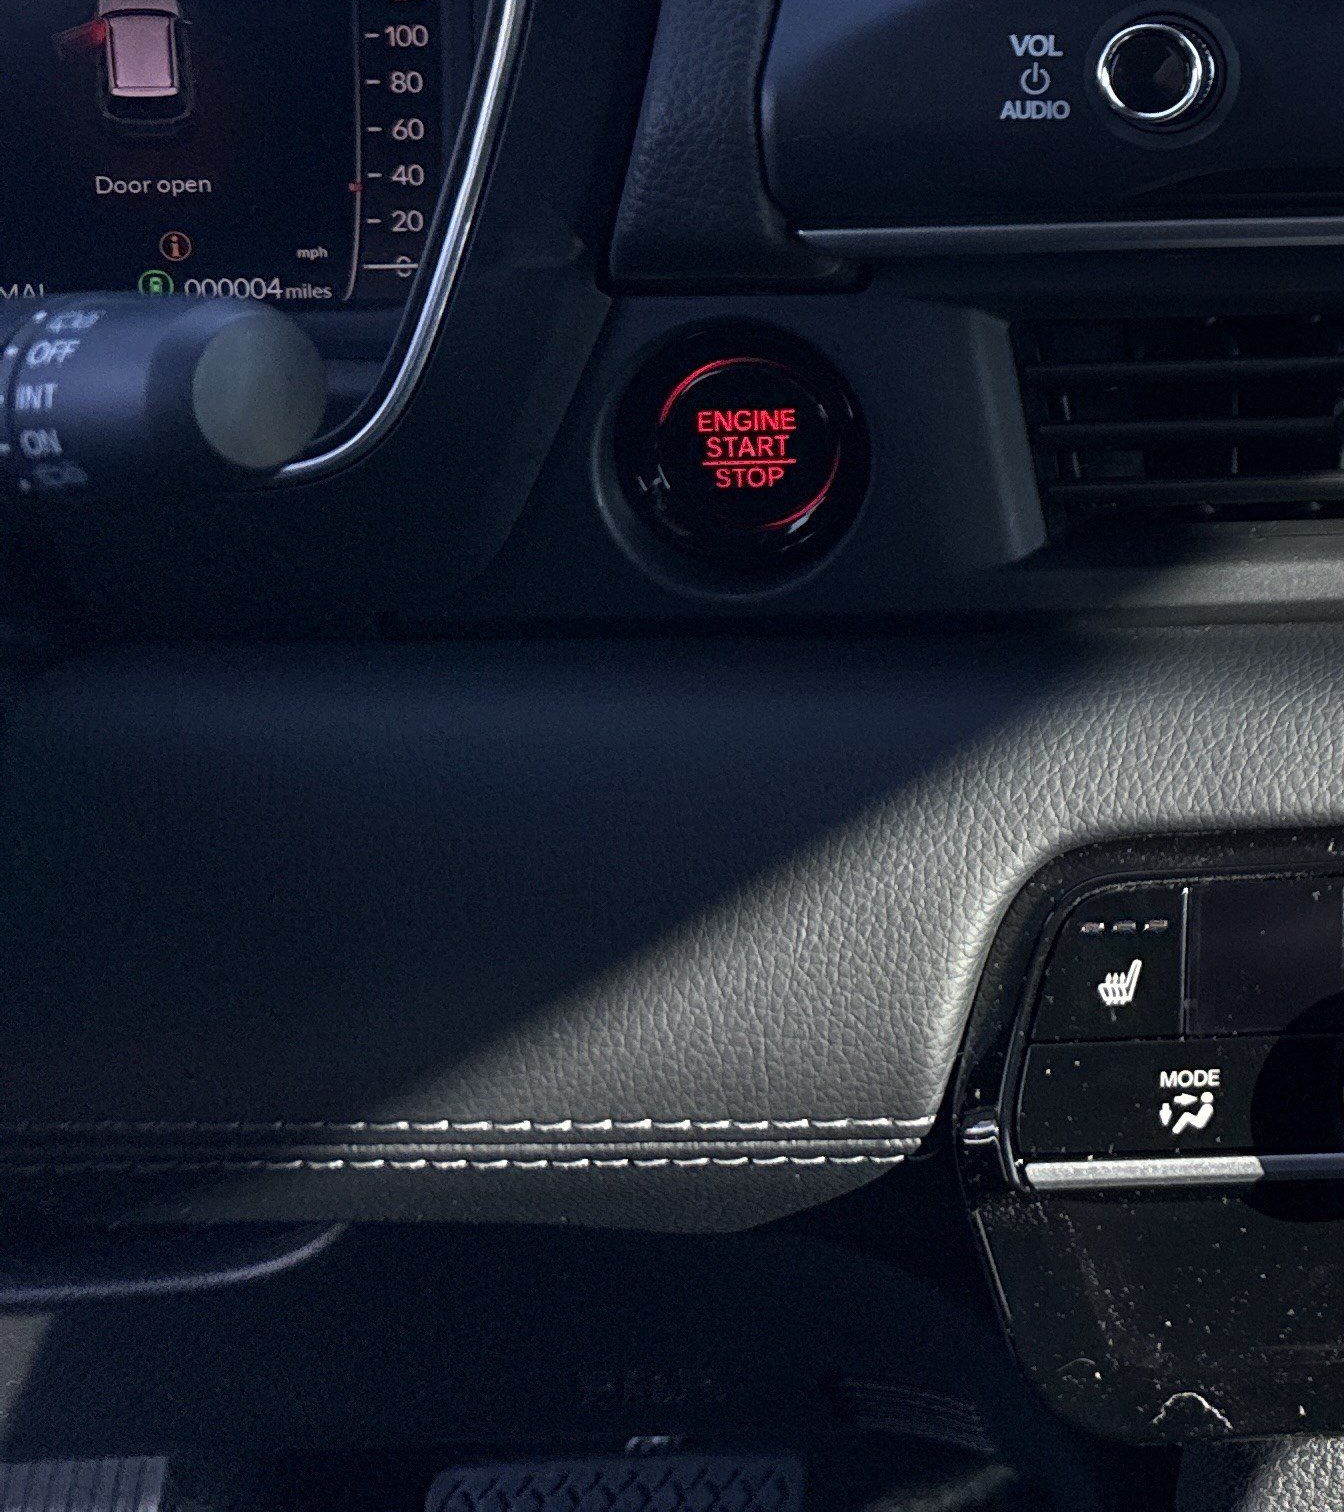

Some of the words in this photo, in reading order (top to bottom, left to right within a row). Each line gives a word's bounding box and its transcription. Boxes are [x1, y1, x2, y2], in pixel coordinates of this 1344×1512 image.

[385, 24, 430, 48] 100
[1009, 34, 1063, 57] VOL
[390, 70, 424, 94] 80
[1000, 100, 1071, 120] AUDIO
[391, 117, 425, 141] 60
[95, 175, 150, 195] Door
[156, 177, 212, 197] open
[391, 163, 425, 187] 40
[391, 209, 424, 233] 20
[296, 245, 329, 261] mph
[285, 284, 334, 300] miles
[697, 408, 798, 433] ENGINE
[706, 434, 790, 459] START
[715, 466, 785, 489] STOP
[1159, 1068, 1221, 1088] MODE
